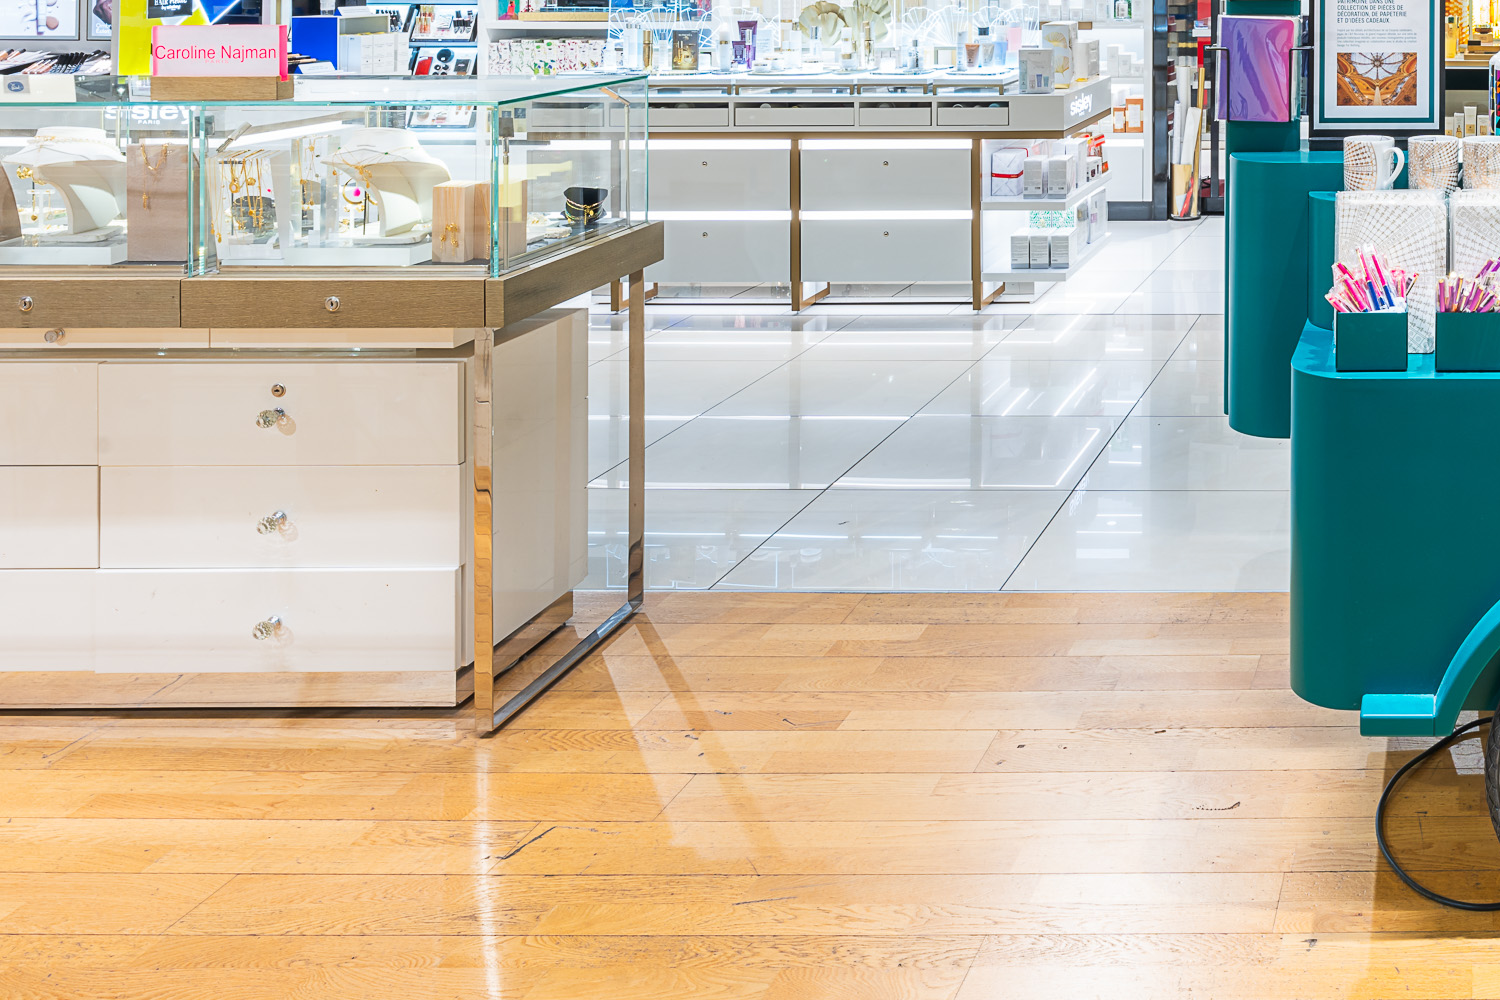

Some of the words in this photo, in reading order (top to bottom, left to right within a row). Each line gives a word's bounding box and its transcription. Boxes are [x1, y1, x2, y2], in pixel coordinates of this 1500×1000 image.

[155, 45, 216, 60] Caroline
[221, 45, 277, 62] Najman
[1070, 92, 1093, 116] sisley
